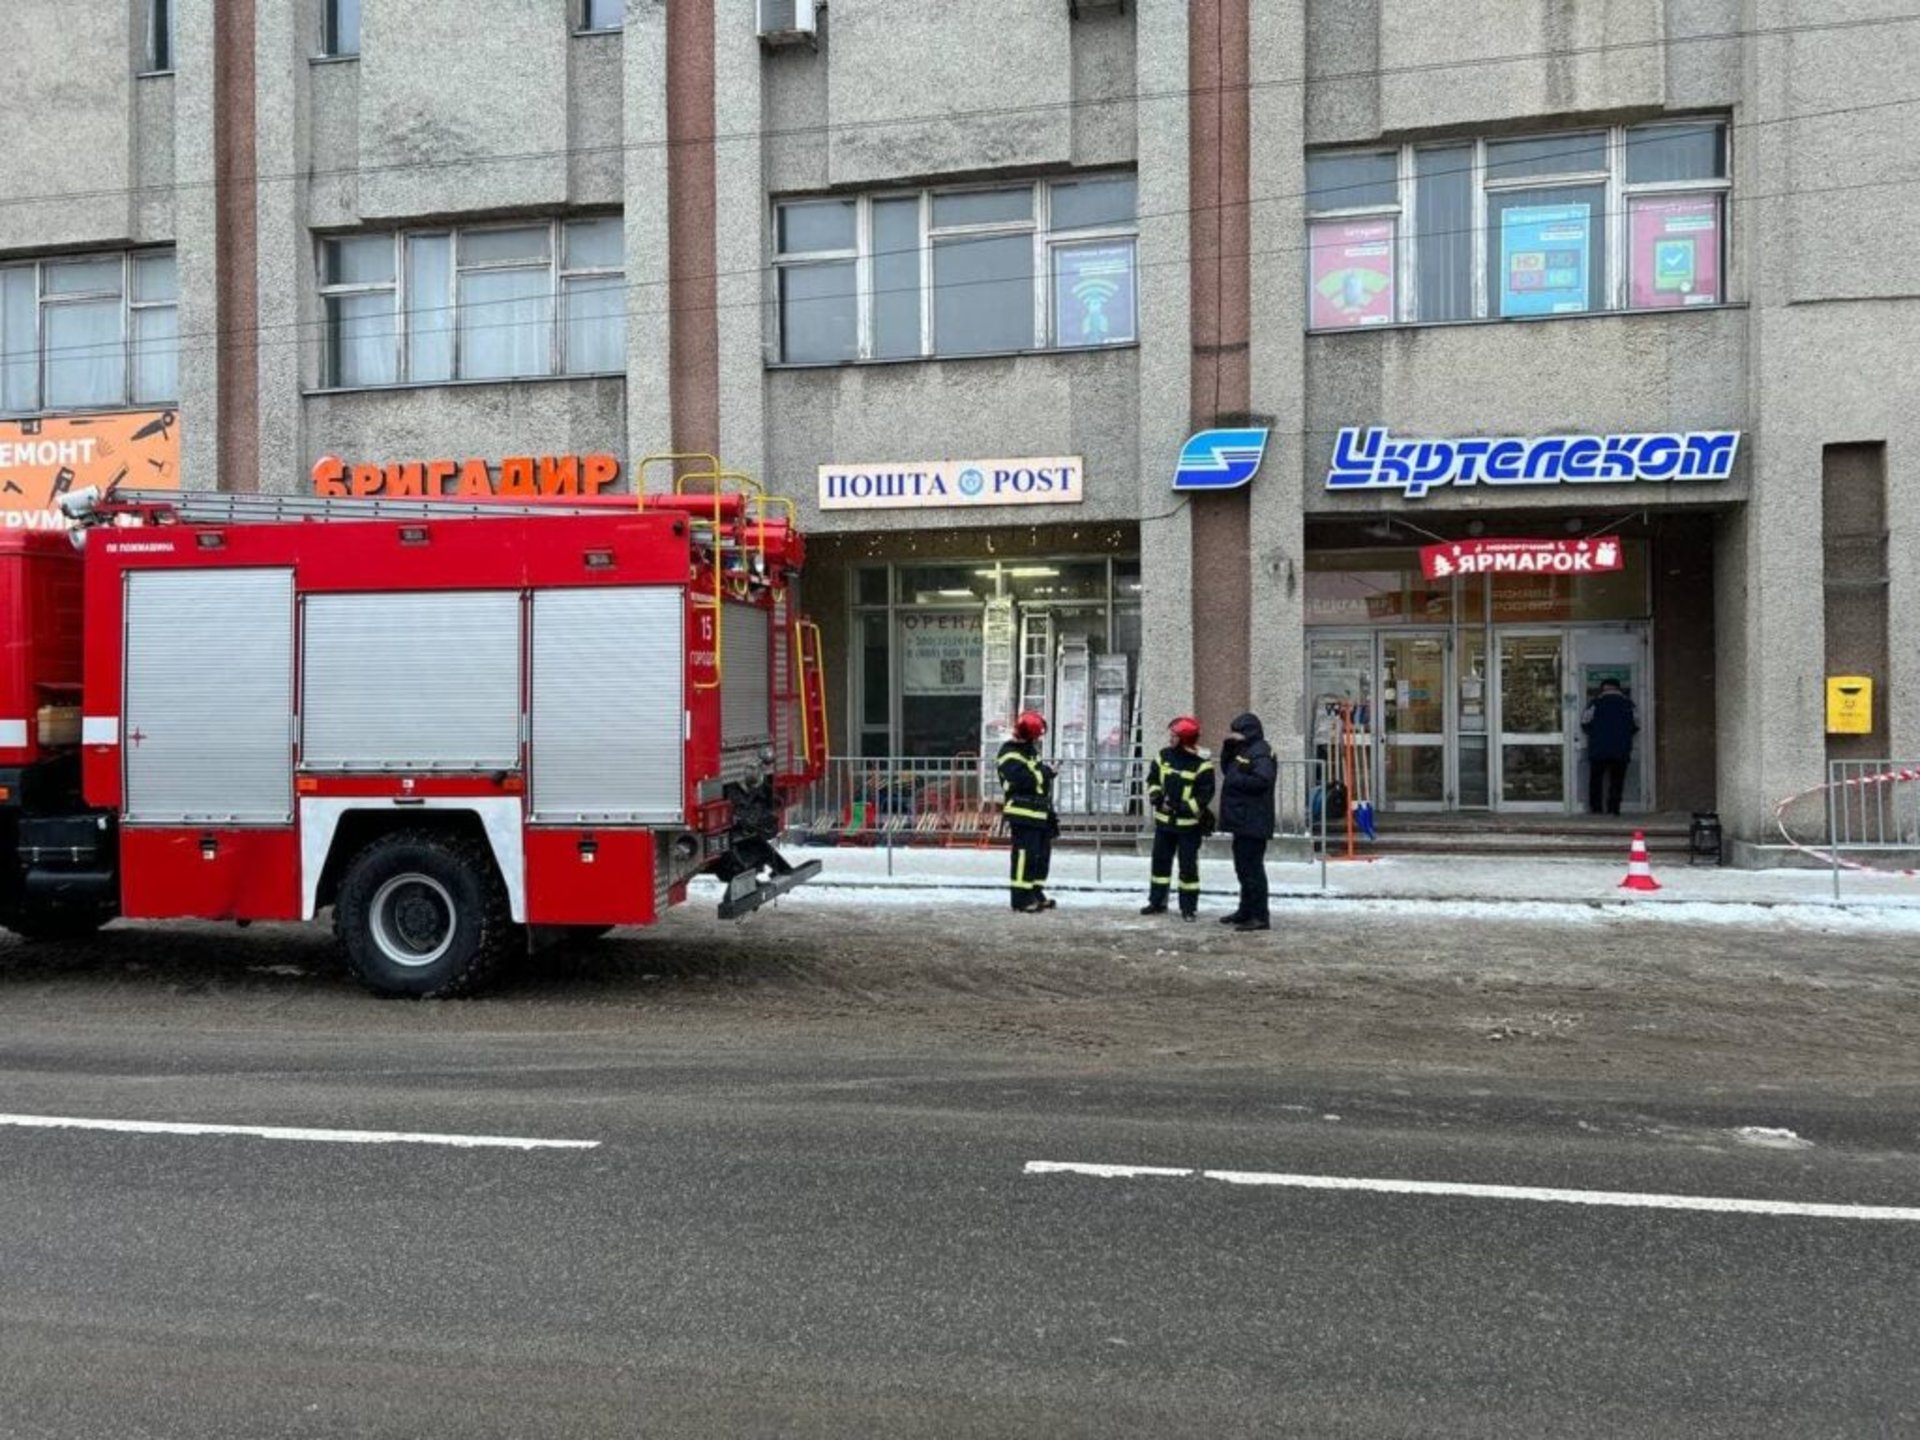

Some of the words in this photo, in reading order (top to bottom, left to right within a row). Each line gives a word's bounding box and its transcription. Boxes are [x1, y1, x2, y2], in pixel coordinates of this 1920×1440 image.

[312, 454, 618, 496] БРИГАДИР
[1326, 428, 1741, 497] Укртелеком
[827, 472, 947, 498] ПОШТА
[993, 467, 1076, 493] POST
[1457, 552, 1593, 574] ЯРМАРОК
[701, 615, 712, 640] 15
[905, 614, 984, 631] ОРЕНД
